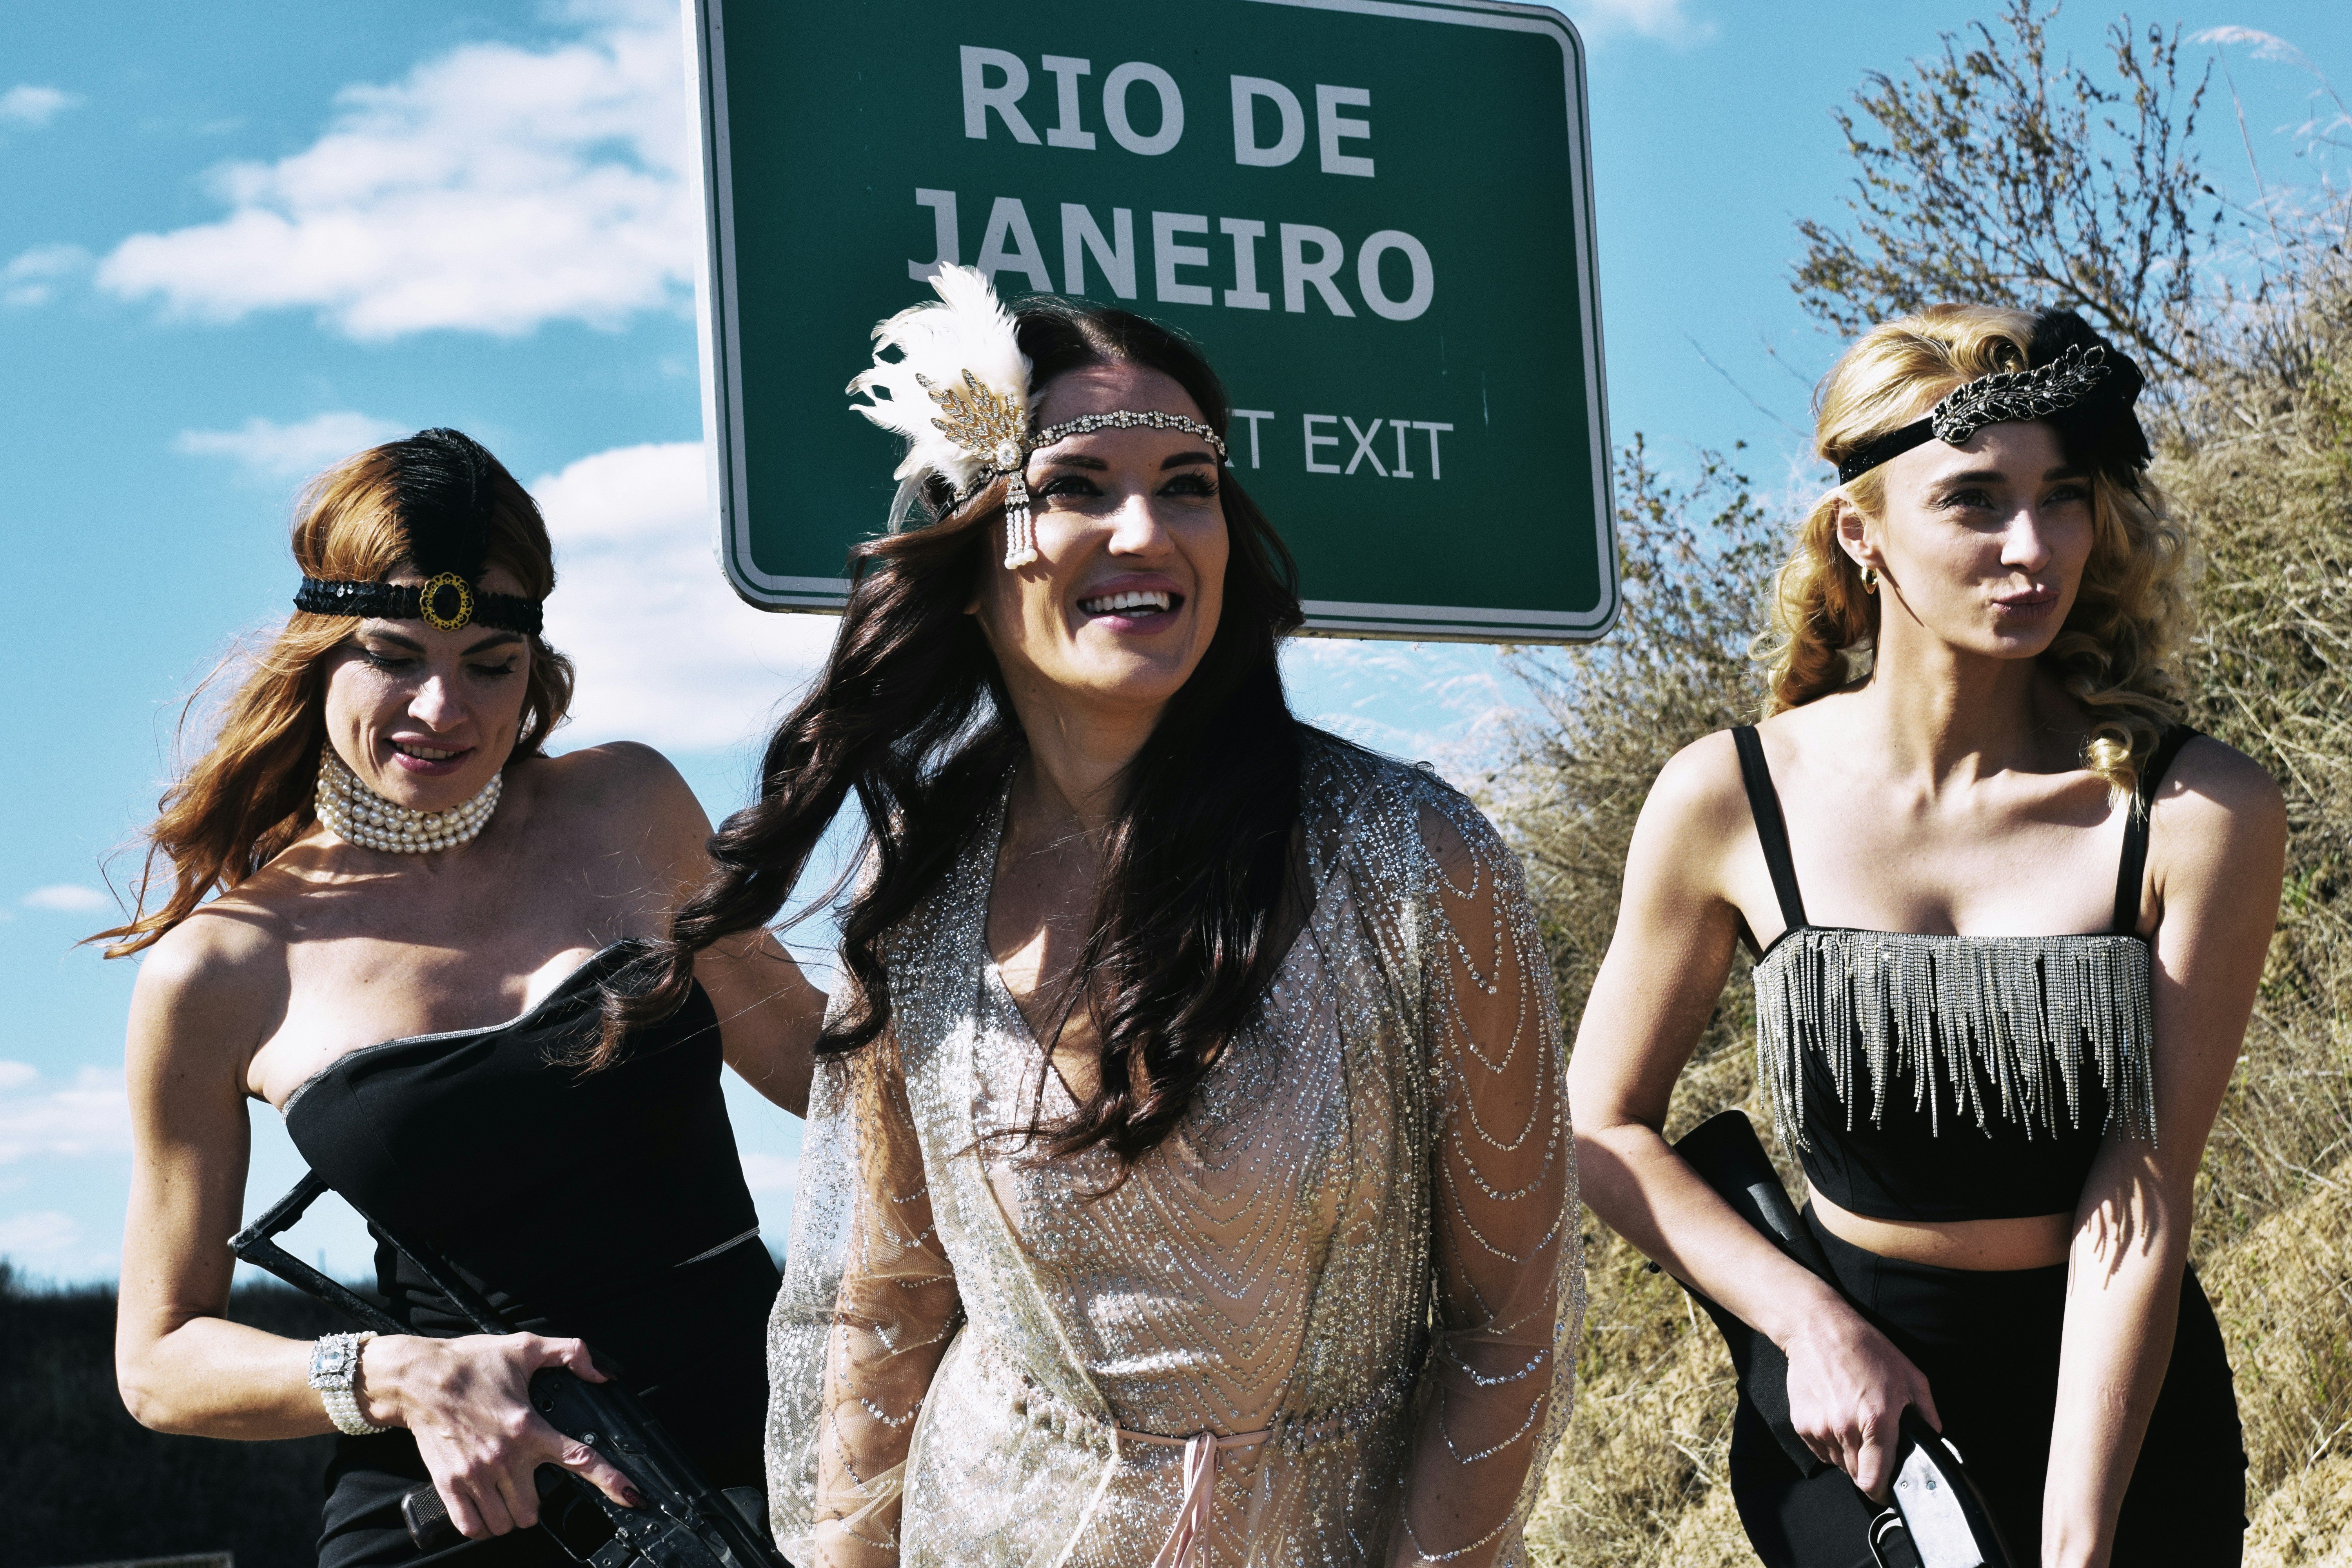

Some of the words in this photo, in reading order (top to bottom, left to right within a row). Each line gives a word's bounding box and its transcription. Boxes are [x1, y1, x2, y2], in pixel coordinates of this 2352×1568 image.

[960, 45, 1184, 155] RIO
[1230, 75, 1374, 177] DE
[908, 188, 1434, 321] JANEIRO
[1303, 414, 1454, 480] EXIT
